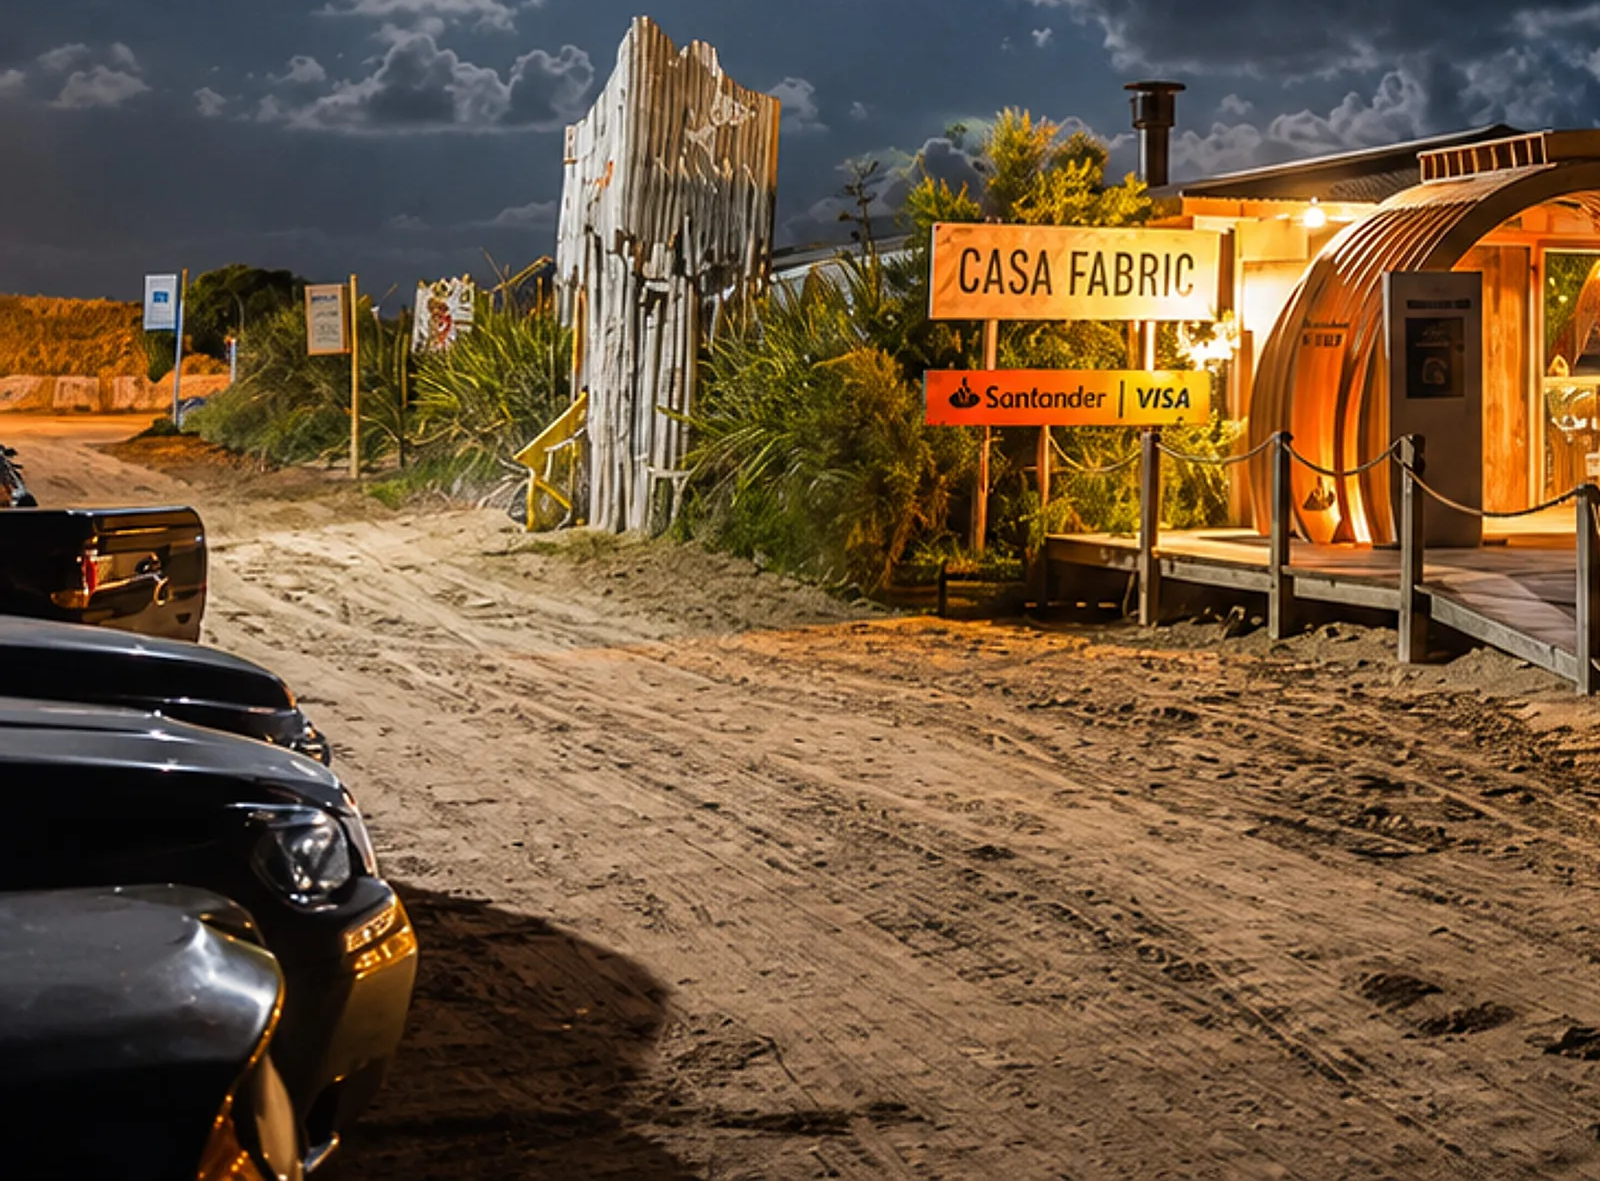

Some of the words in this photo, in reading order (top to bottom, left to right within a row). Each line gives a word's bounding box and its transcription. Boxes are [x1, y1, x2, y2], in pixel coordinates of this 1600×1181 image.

[959, 247, 1052, 296] CASA
[1069, 251, 1195, 298] FABRIC
[986, 385, 1107, 409] Santander
[1136, 387, 1191, 409] VISA
